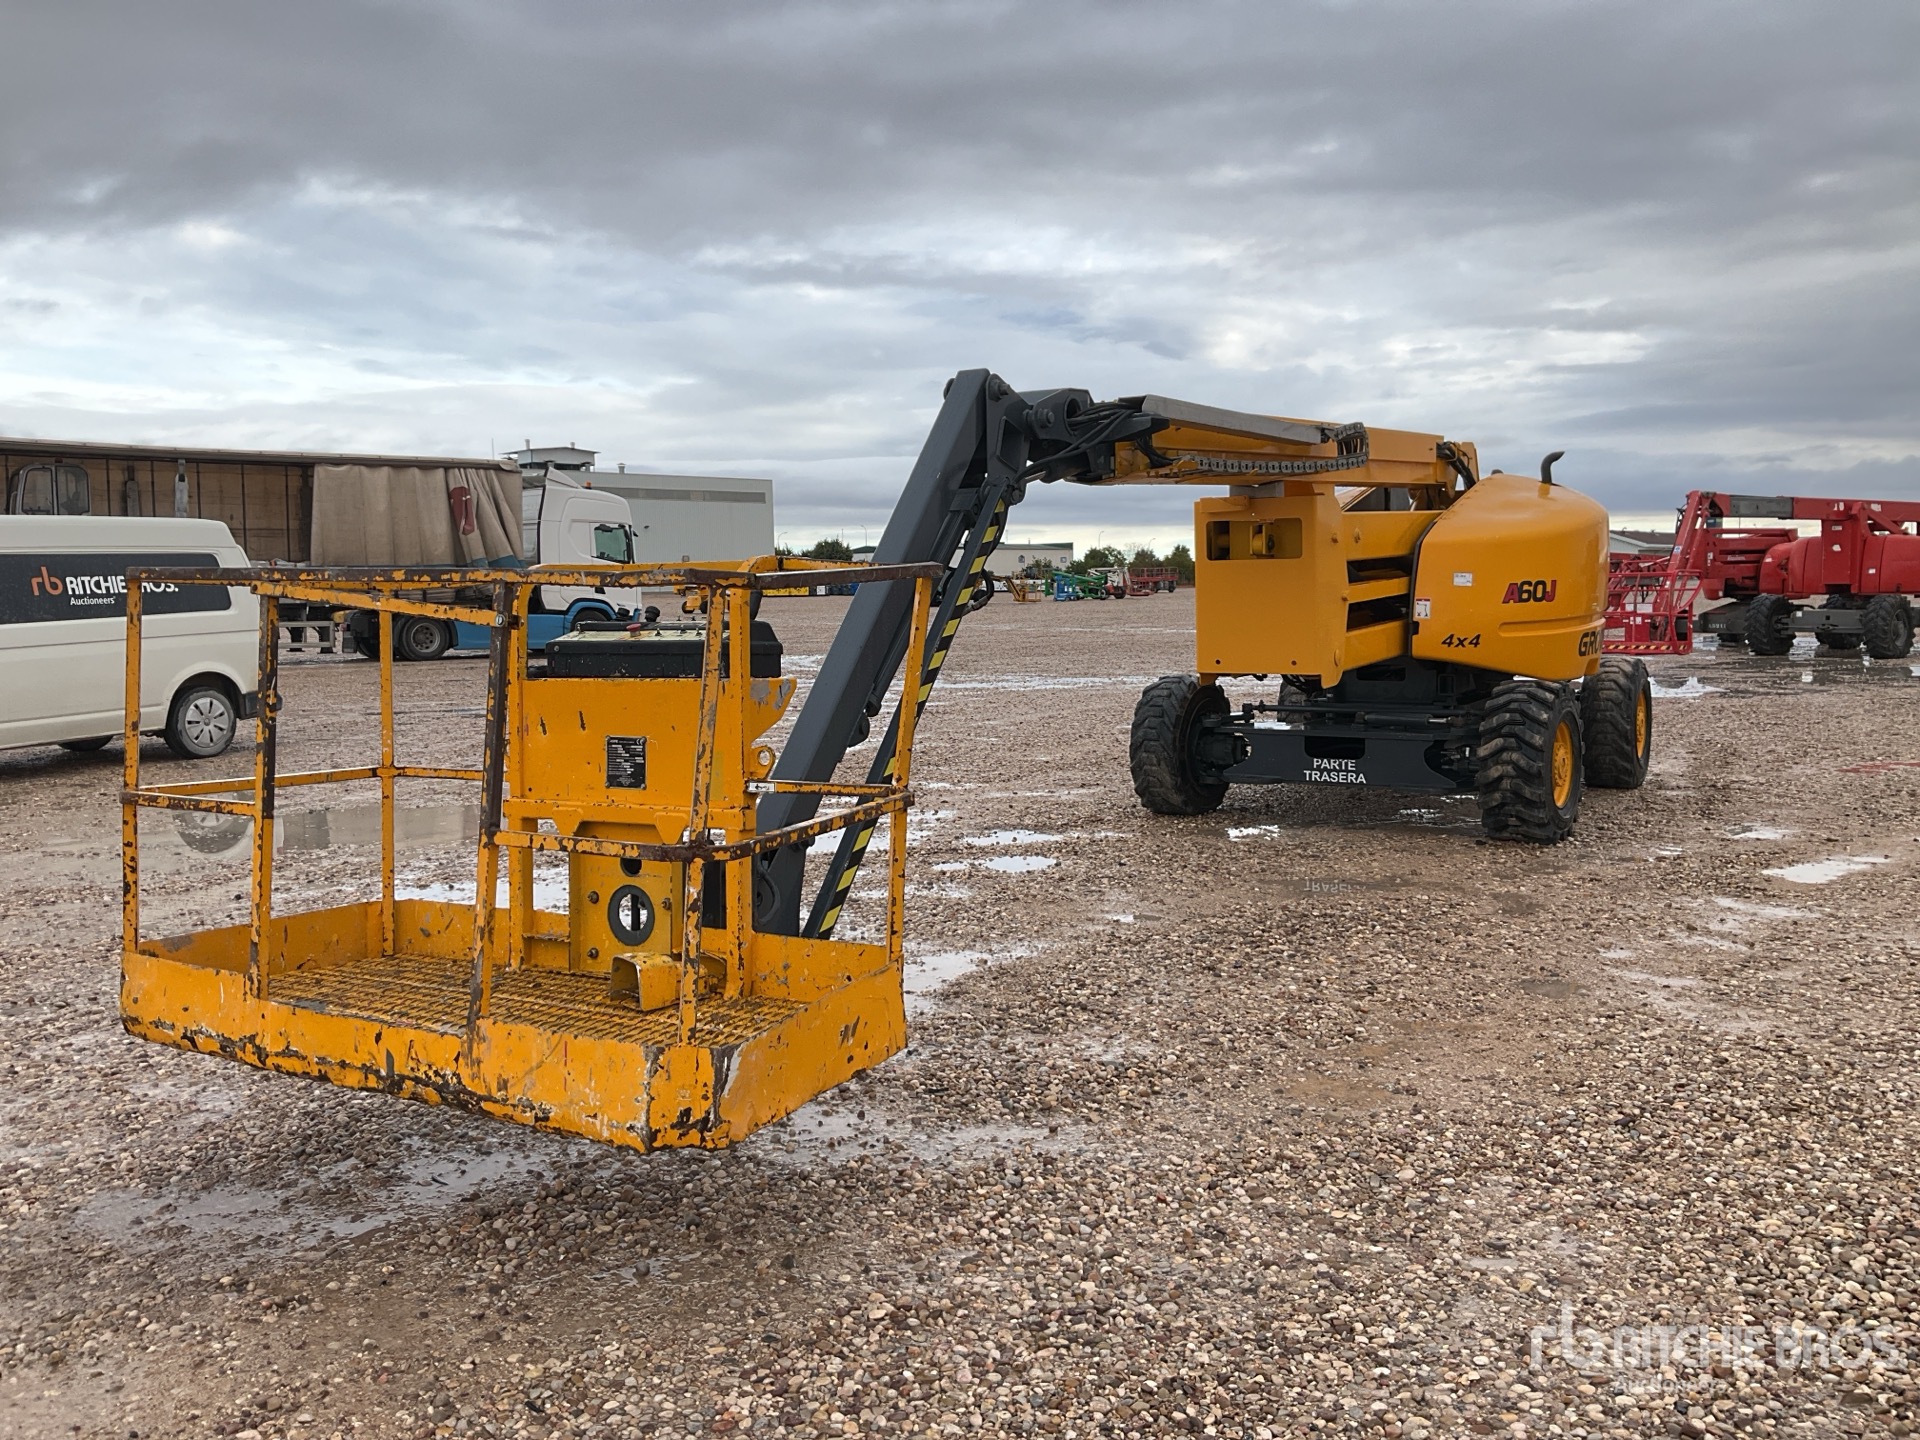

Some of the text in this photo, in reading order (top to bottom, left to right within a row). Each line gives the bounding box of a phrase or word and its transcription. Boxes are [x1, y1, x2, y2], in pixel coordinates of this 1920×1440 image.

[31, 566, 63, 596] rb
[65, 575, 128, 595] RITCHIE
[1501, 579, 1557, 604] A60J
[70, 596, 114, 606] Auctioneers
[1441, 633, 1481, 648] 4x4
[1313, 758, 1356, 771] PARTE
[1303, 770, 1367, 784] TRASERA
